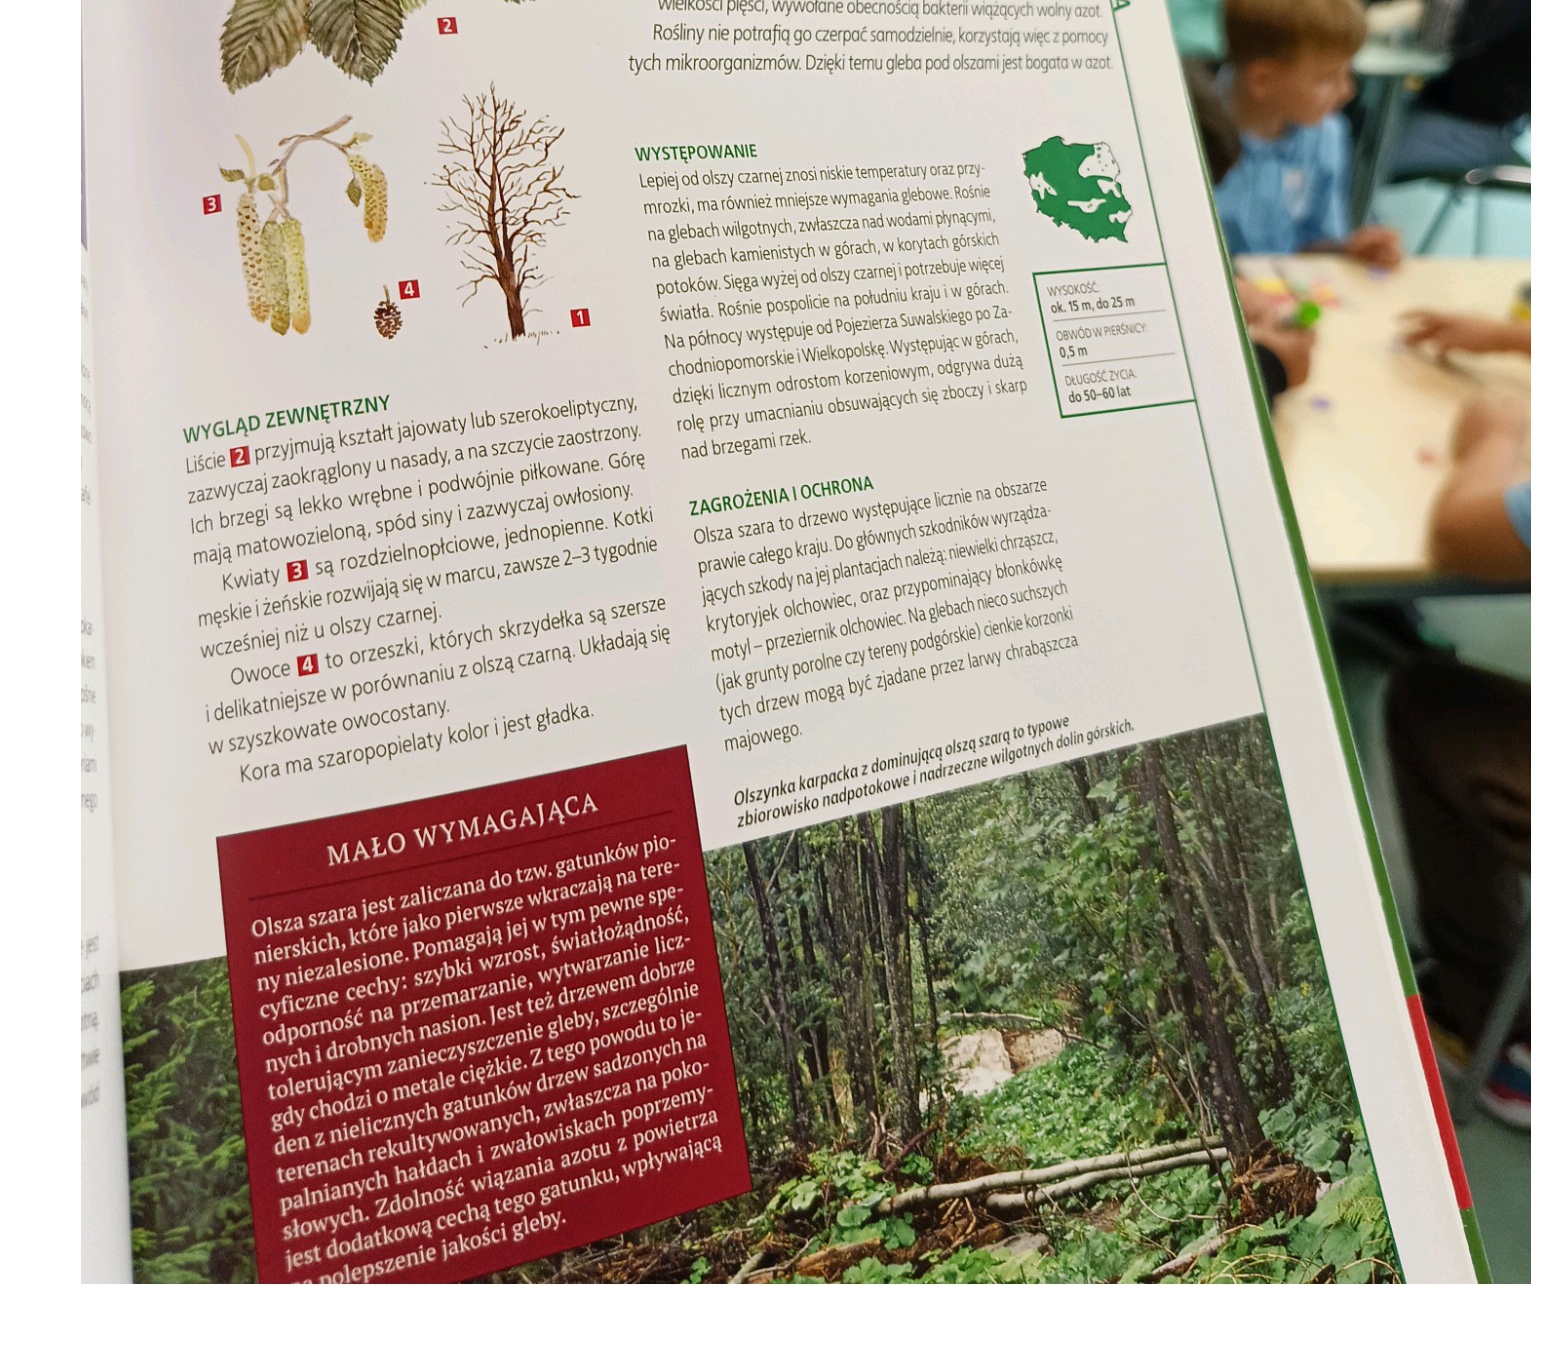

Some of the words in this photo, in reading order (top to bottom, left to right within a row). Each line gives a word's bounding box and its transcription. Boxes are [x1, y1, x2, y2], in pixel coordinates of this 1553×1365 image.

[634, 143, 758, 164] WYSTĘPOWANIE
[1050, 301, 1067, 314] ok.
[1068, 299, 1080, 312] 15
[1081, 301, 1095, 312] m,
[1096, 297, 1110, 309] do
[1110, 296, 1123, 308] 25
[1125, 297, 1135, 307] m
[1059, 345, 1076, 359] 0,5
[1077, 347, 1088, 357] m
[183, 415, 260, 443] WYGLĄD
[265, 394, 390, 429] ZEWNĘTRZNY
[689, 487, 790, 516] ZAGROŻENIA
[792, 486, 797, 501] I
[800, 476, 874, 499] OCHRONA
[734, 779, 796, 806] Olszynka
[799, 765, 858, 791] karpacka
[861, 764, 868, 776] z
[871, 747, 943, 773] dominującą
[945, 739, 976, 755] olszą
[979, 731, 1010, 748] szarą
[1012, 727, 1025, 739] to
[1027, 717, 1069, 739] typowe
[327, 832, 406, 866] MAŁO
[413, 793, 599, 848] WYMAGAJĄCA
[252, 916, 304, 937] Olsza
[308, 905, 358, 927] szara
[362, 895, 396, 921] jest
[400, 879, 486, 909] zaliczana
[489, 871, 512, 889] do
[516, 864, 552, 883] tzw.
[555, 843, 639, 879] gatunków
[642, 837, 676, 859] pio-
